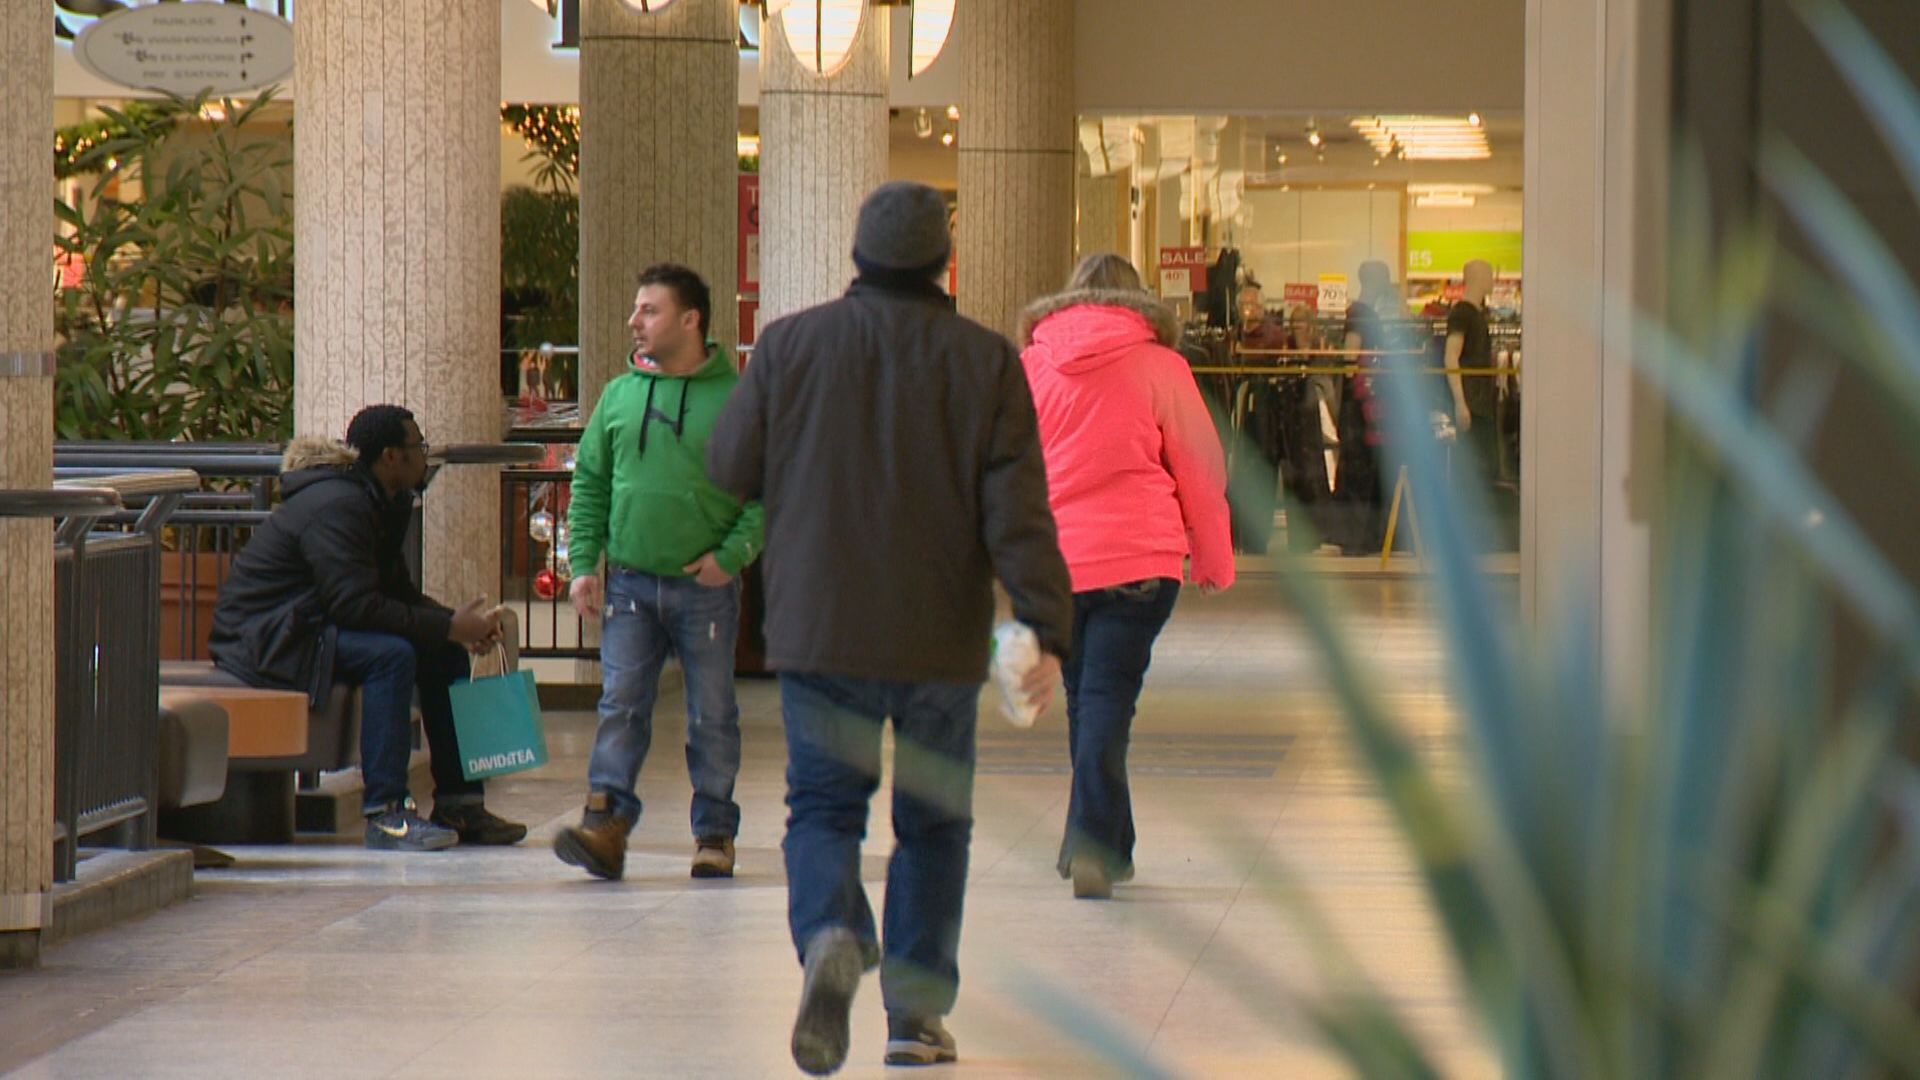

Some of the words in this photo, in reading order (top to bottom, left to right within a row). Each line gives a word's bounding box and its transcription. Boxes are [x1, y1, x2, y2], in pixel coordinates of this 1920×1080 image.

[160, 53, 234, 62] ELEVATORS
[174, 70, 229, 79] STATION
[1162, 252, 1204, 265] SALE
[1286, 286, 1316, 296] SALE
